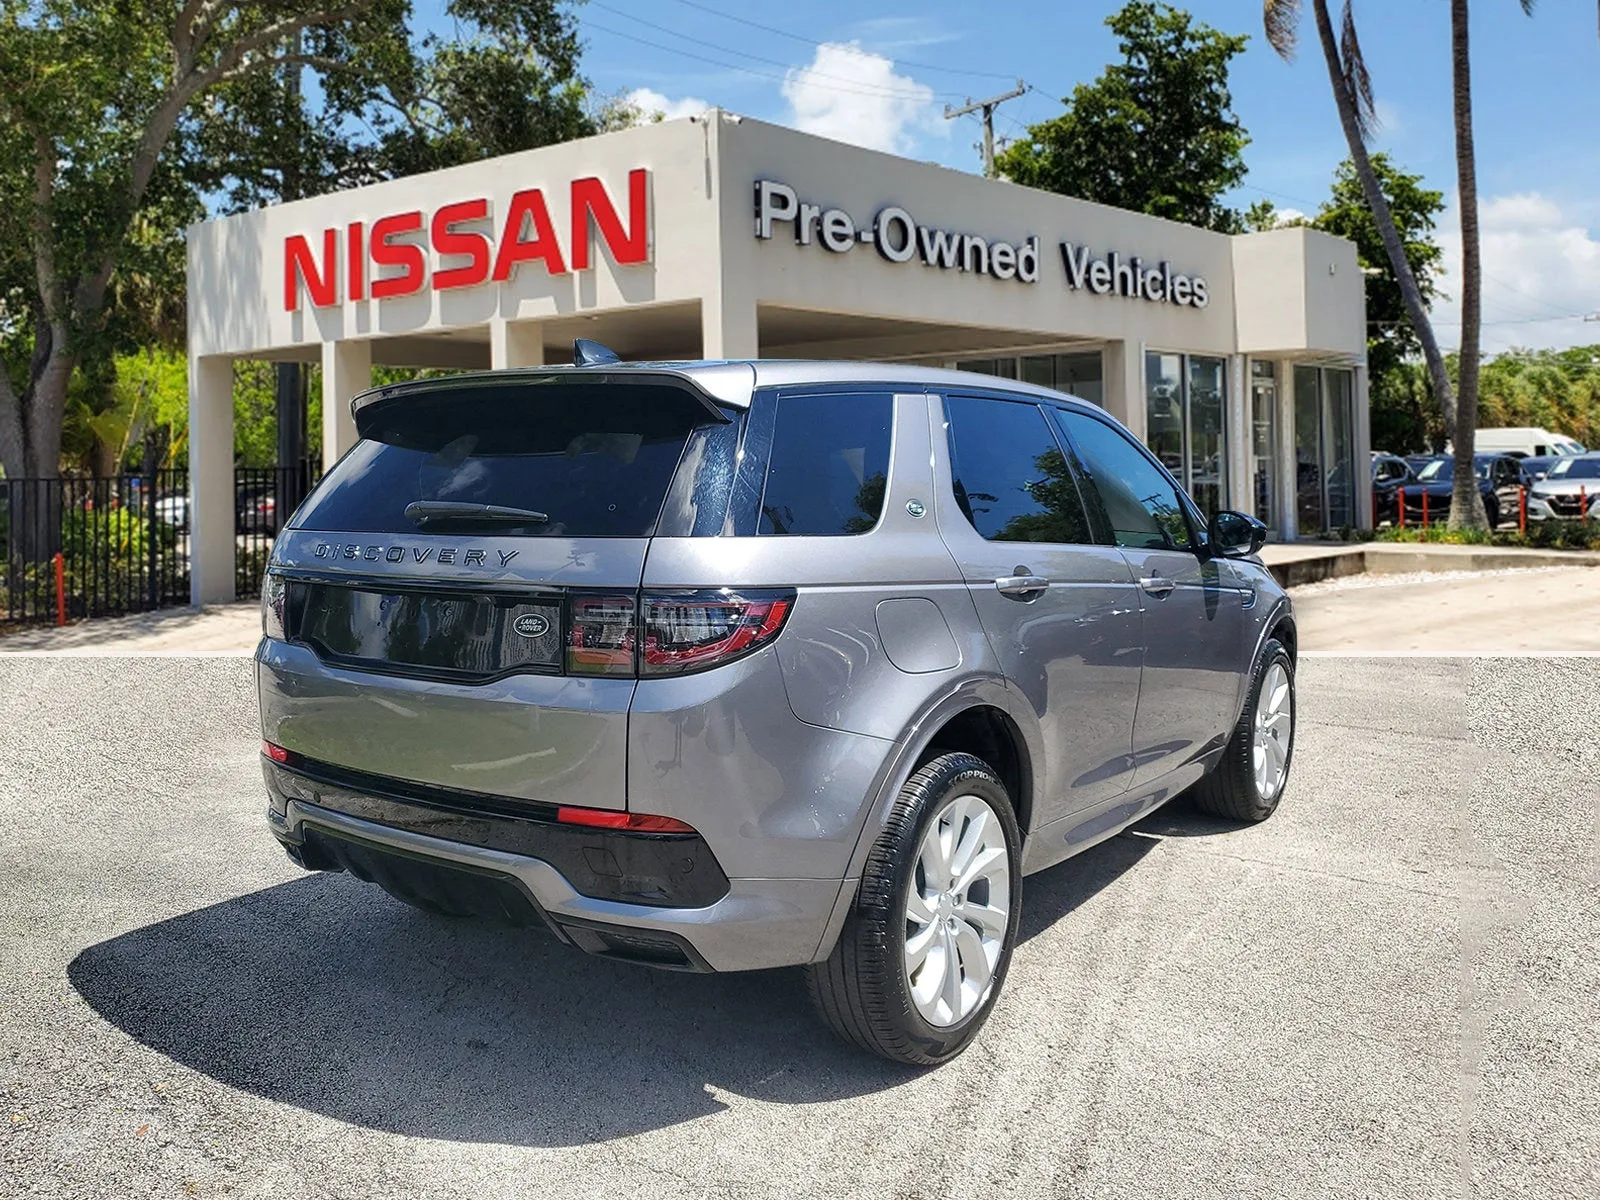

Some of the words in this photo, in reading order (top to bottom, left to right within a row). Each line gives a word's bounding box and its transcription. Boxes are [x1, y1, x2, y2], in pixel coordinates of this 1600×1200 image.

[285, 169, 648, 312] NISSAN
[754, 179, 1041, 284] Pre-Owned
[1059, 241, 1209, 308] Vehicles
[314, 543, 520, 567] DISCOVERY
